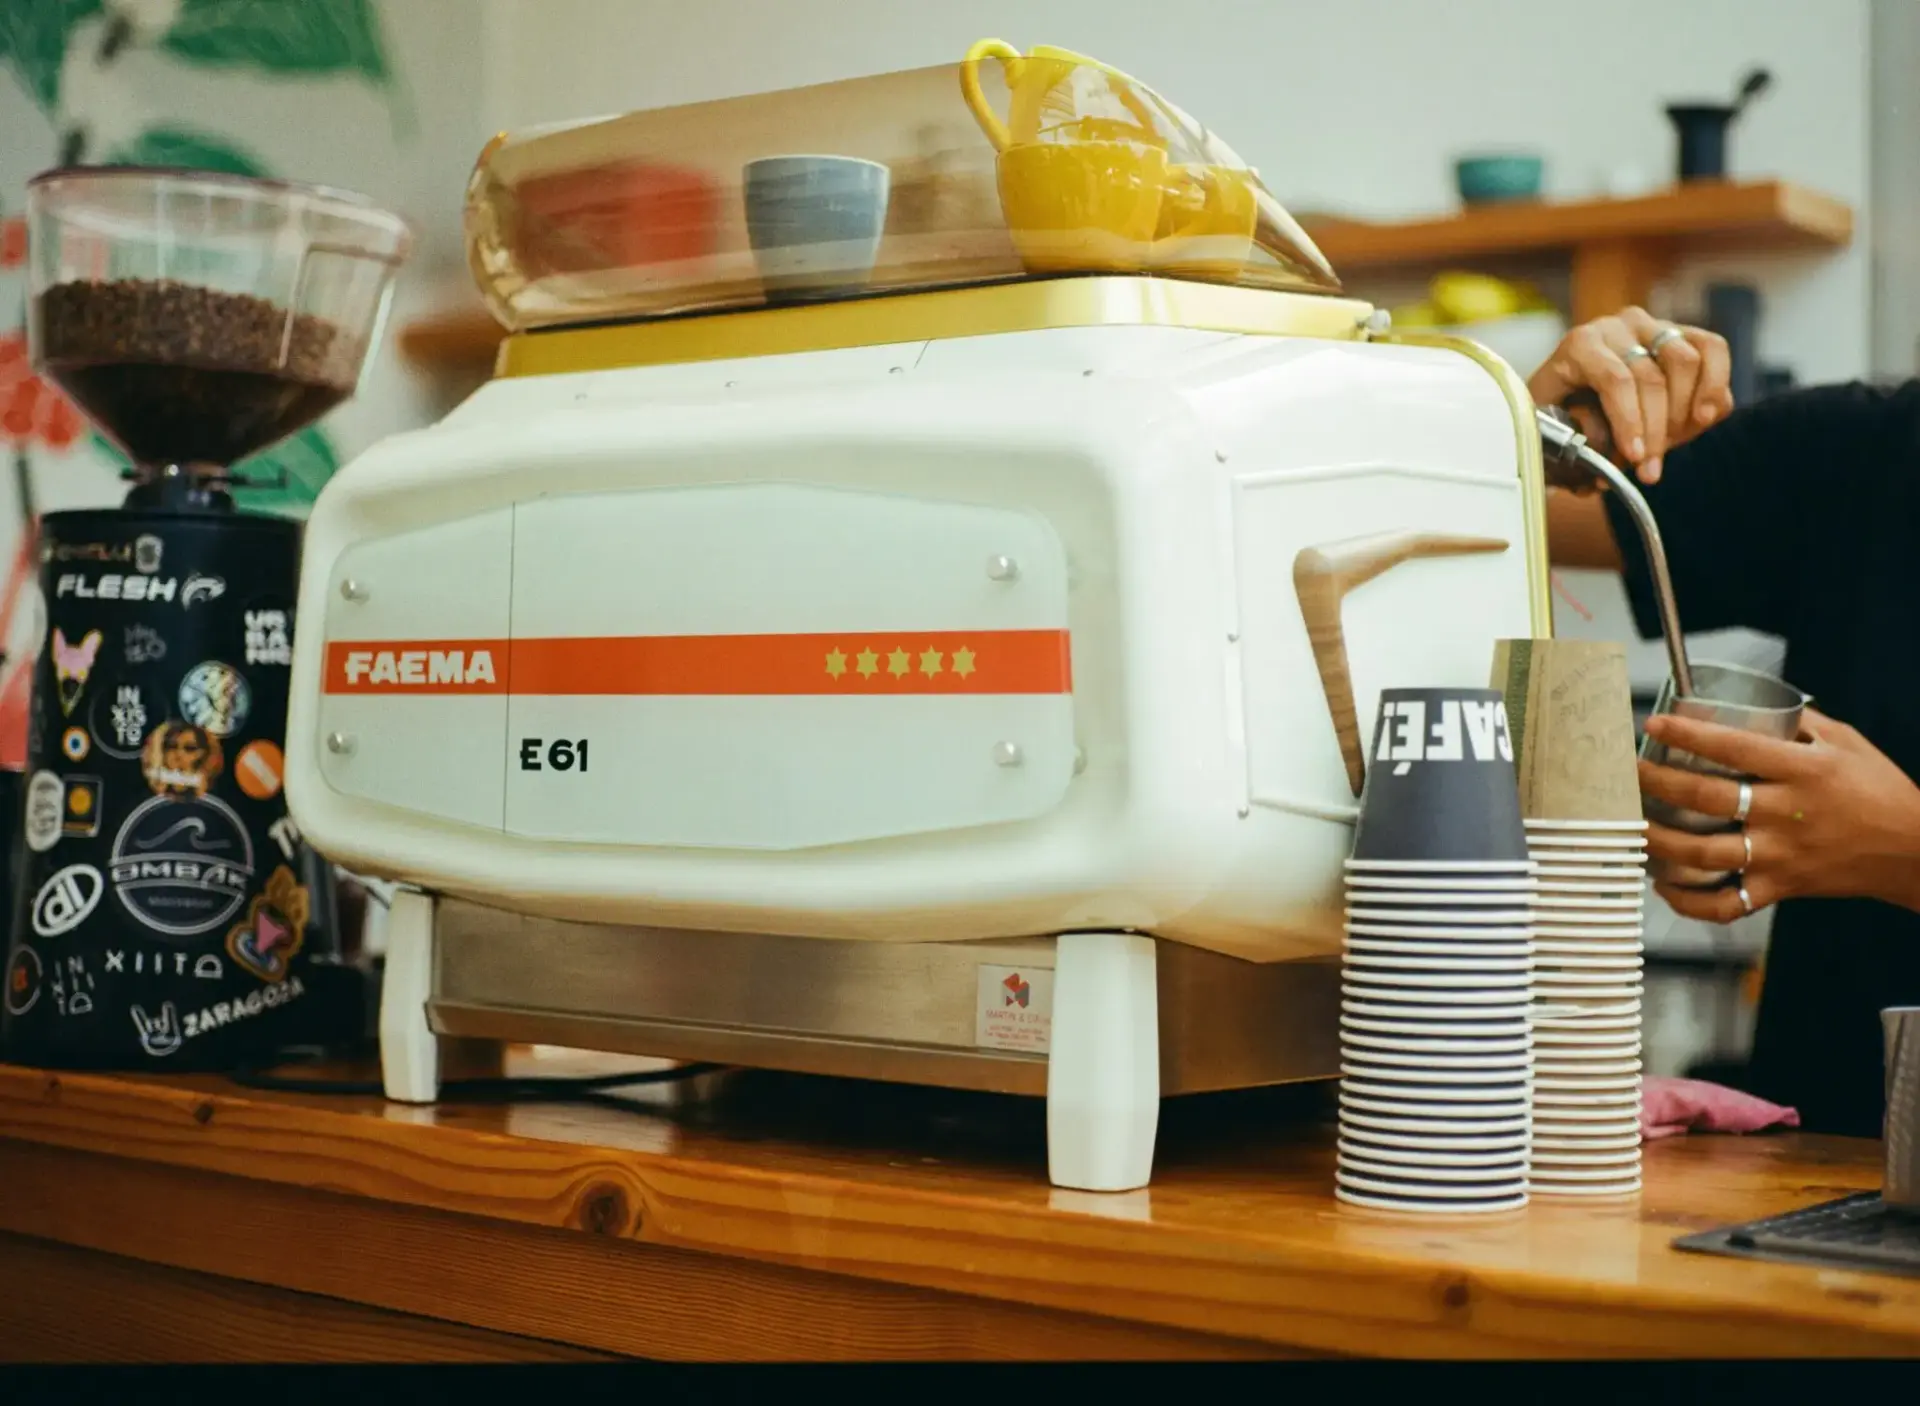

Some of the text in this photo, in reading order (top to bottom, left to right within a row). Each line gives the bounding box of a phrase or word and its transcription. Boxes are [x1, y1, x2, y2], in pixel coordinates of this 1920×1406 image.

[57, 574, 178, 602] FLESH
[344, 651, 496, 684] FAEMA
[519, 738, 588, 772] E61
